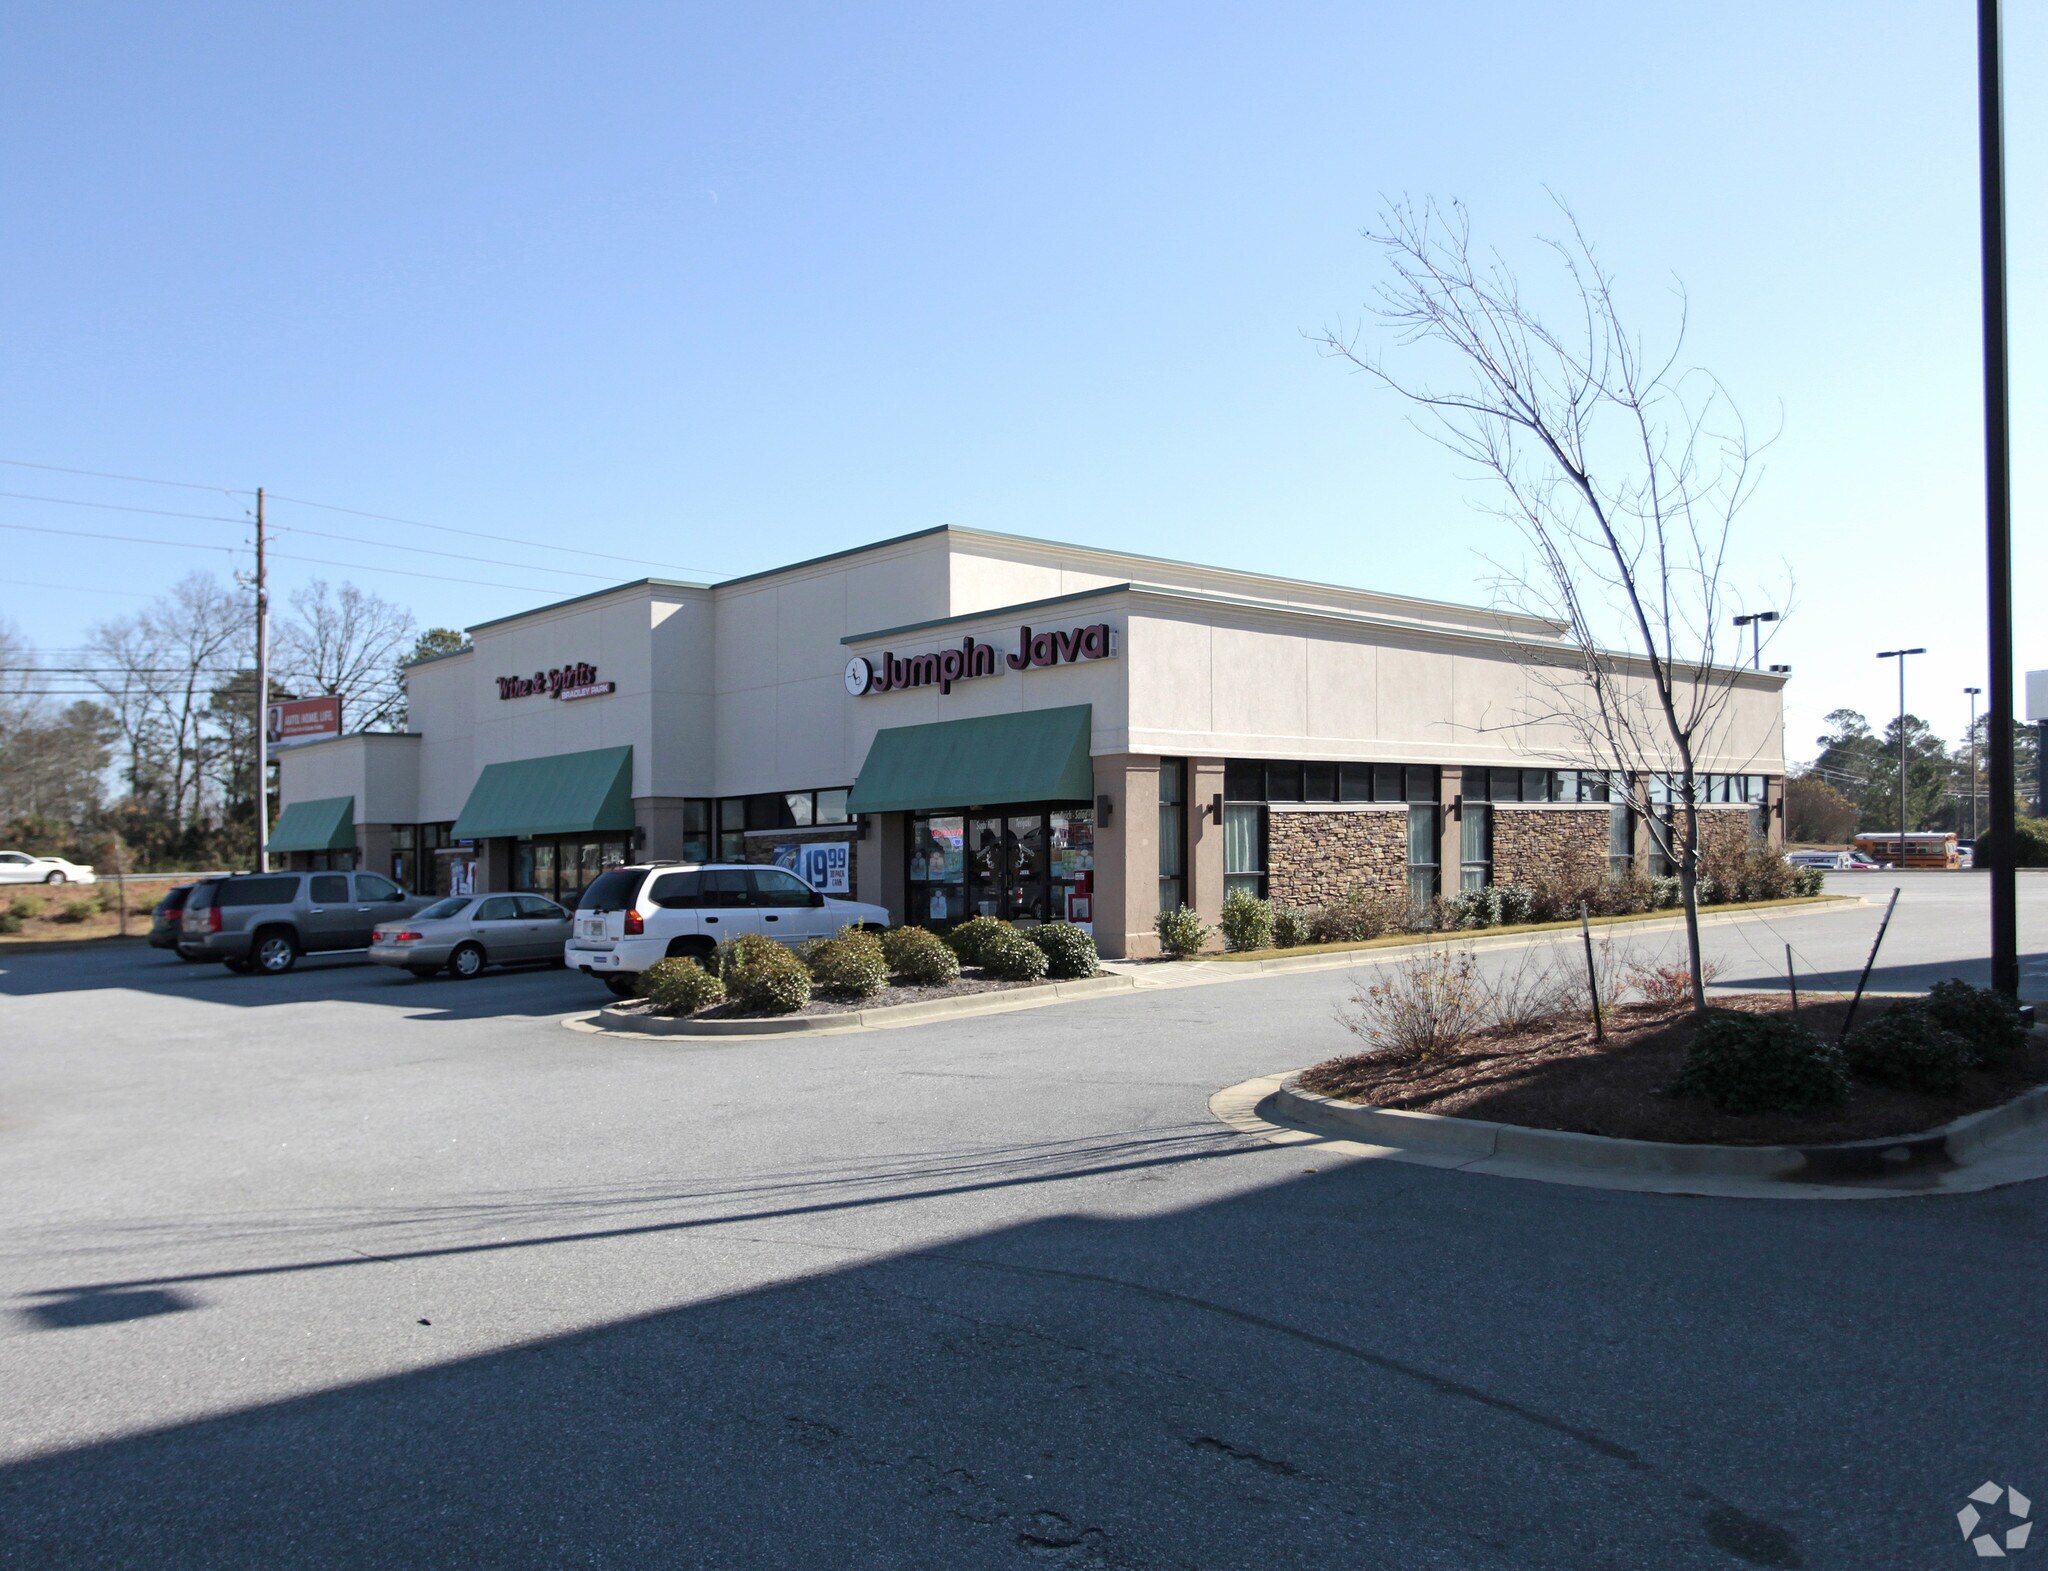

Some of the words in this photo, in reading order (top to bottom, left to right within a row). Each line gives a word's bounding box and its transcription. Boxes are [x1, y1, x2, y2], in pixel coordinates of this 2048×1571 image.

[1006, 623, 1110, 670] Java
[496, 675, 533, 700] Wine
[532, 671, 547, 694] &
[546, 662, 597, 699] Spirits
[561, 687, 591, 700] BRADLEY
[590, 683, 609, 694] PARK
